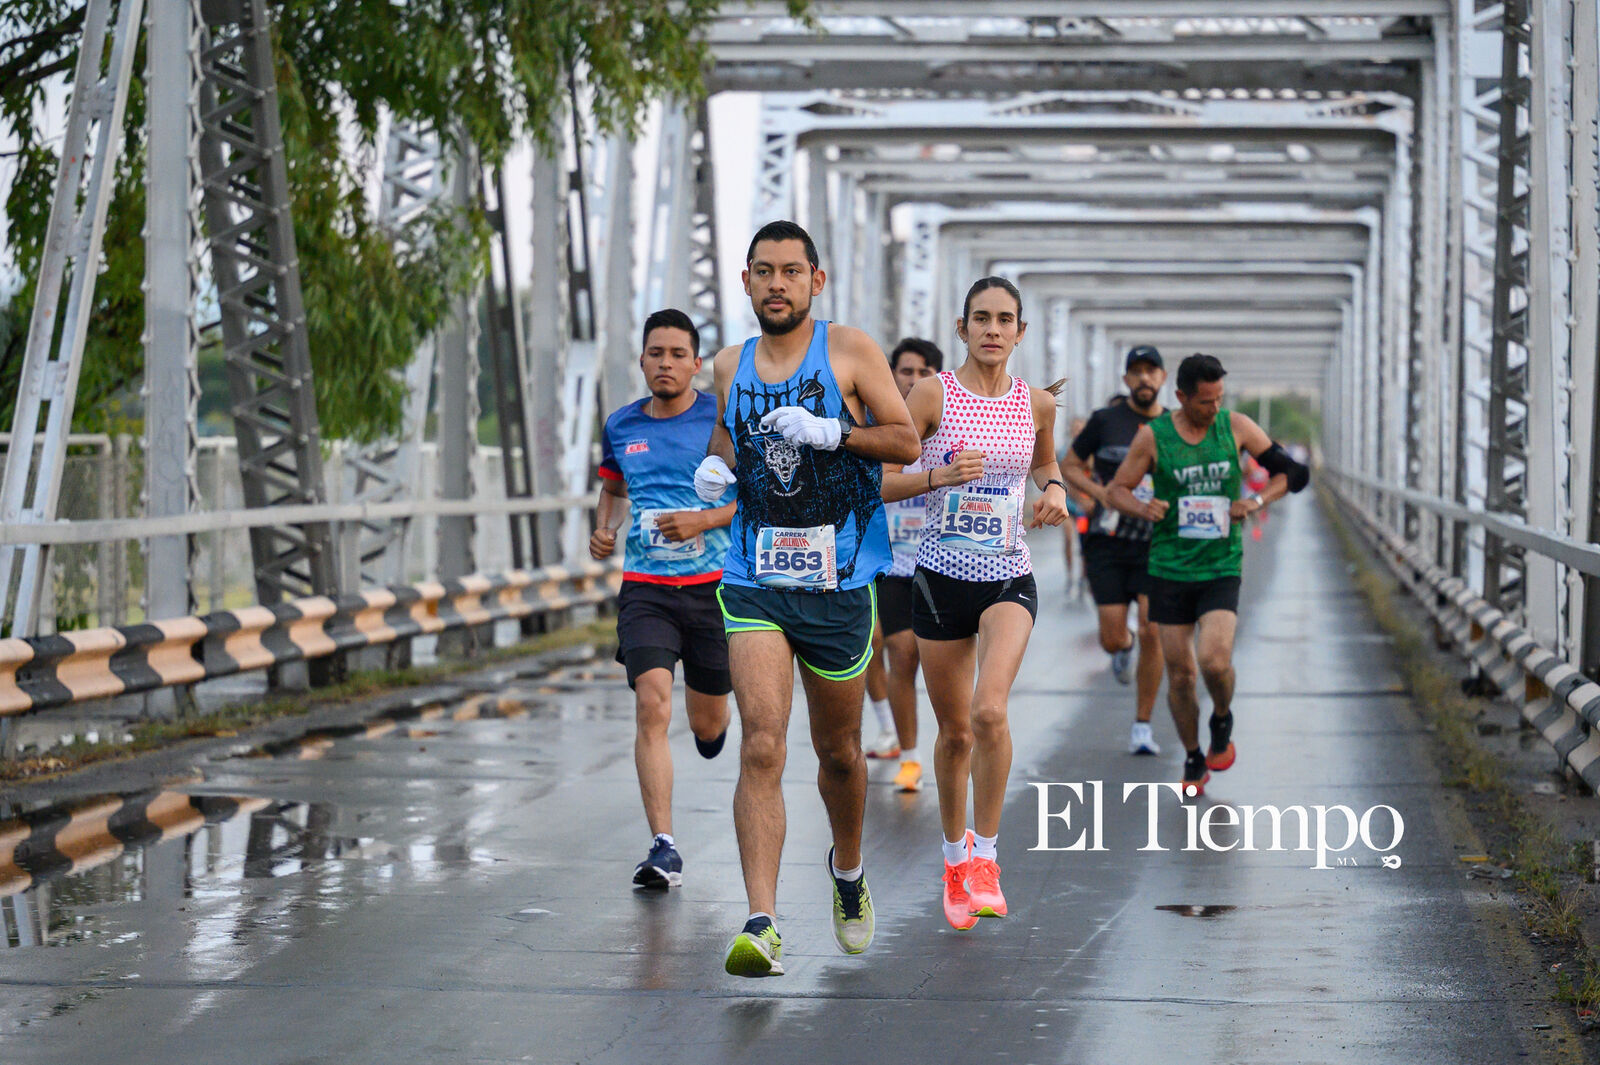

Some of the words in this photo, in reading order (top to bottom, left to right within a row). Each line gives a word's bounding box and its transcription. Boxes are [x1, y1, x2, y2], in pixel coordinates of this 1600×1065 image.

[1173, 461, 1231, 485] VELOZ
[1187, 480, 1222, 496] TEAM
[962, 495, 993, 503] CARRERA
[944, 513, 1003, 536] 1368
[1186, 512, 1215, 525] 961
[760, 551, 823, 571] 1863
